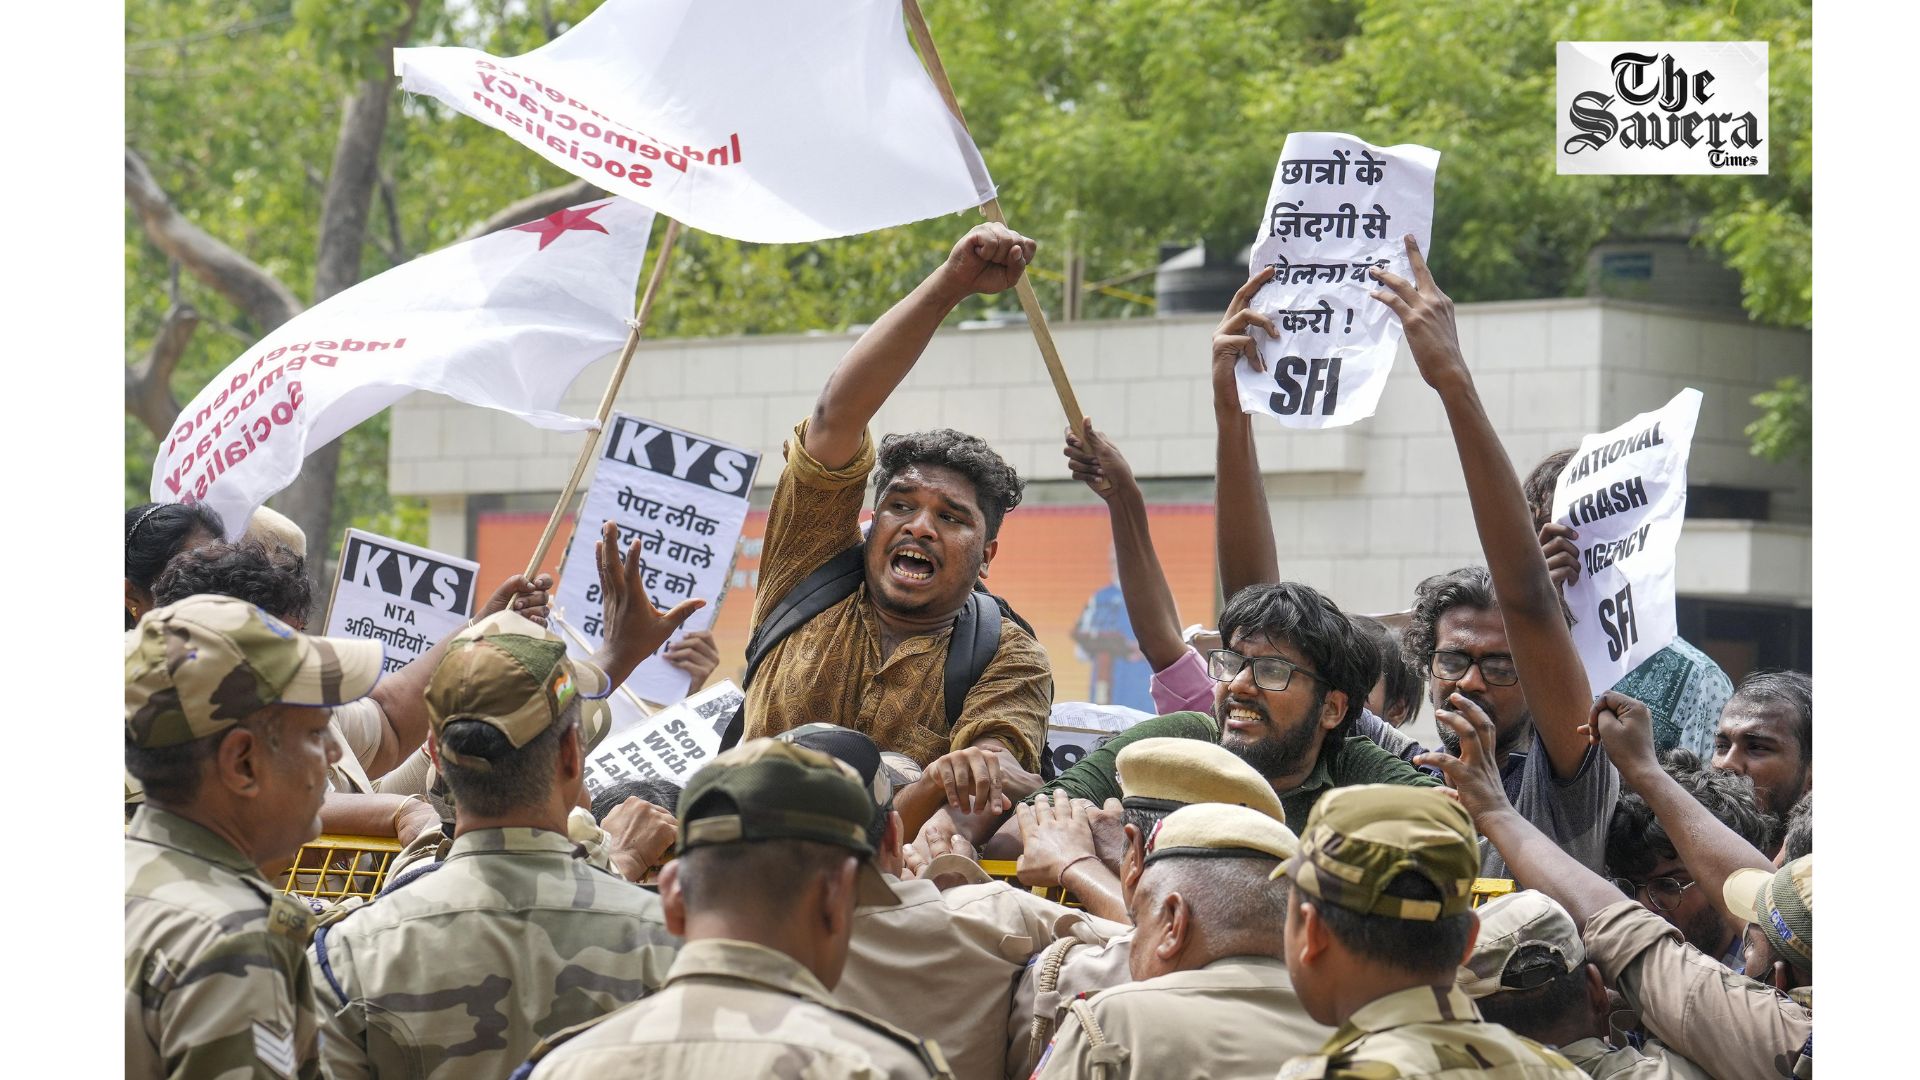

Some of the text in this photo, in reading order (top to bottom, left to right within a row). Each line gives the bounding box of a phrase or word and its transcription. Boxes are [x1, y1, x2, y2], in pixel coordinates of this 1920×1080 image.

[1281, 150, 1386, 186] छात्रों के
[1362, 203, 1391, 240] से
[1279, 299, 1334, 334] करो
[1269, 356, 1342, 416] SFI
[614, 420, 749, 494] KYS
[1566, 421, 1664, 488] NATIONAL
[617, 486, 719, 537] पेपर लीक
[1568, 476, 1648, 527] TRASH
[668, 538, 715, 570] वाले
[1584, 523, 1650, 580] AGENCY
[353, 543, 459, 611] KYS
[664, 572, 697, 598] को
[345, 616, 427, 654] अधिकारियों
[384, 602, 415, 625] NTA
[1598, 582, 1639, 663] SFI
[643, 730, 688, 775] With
[664, 719, 706, 760] Stop
